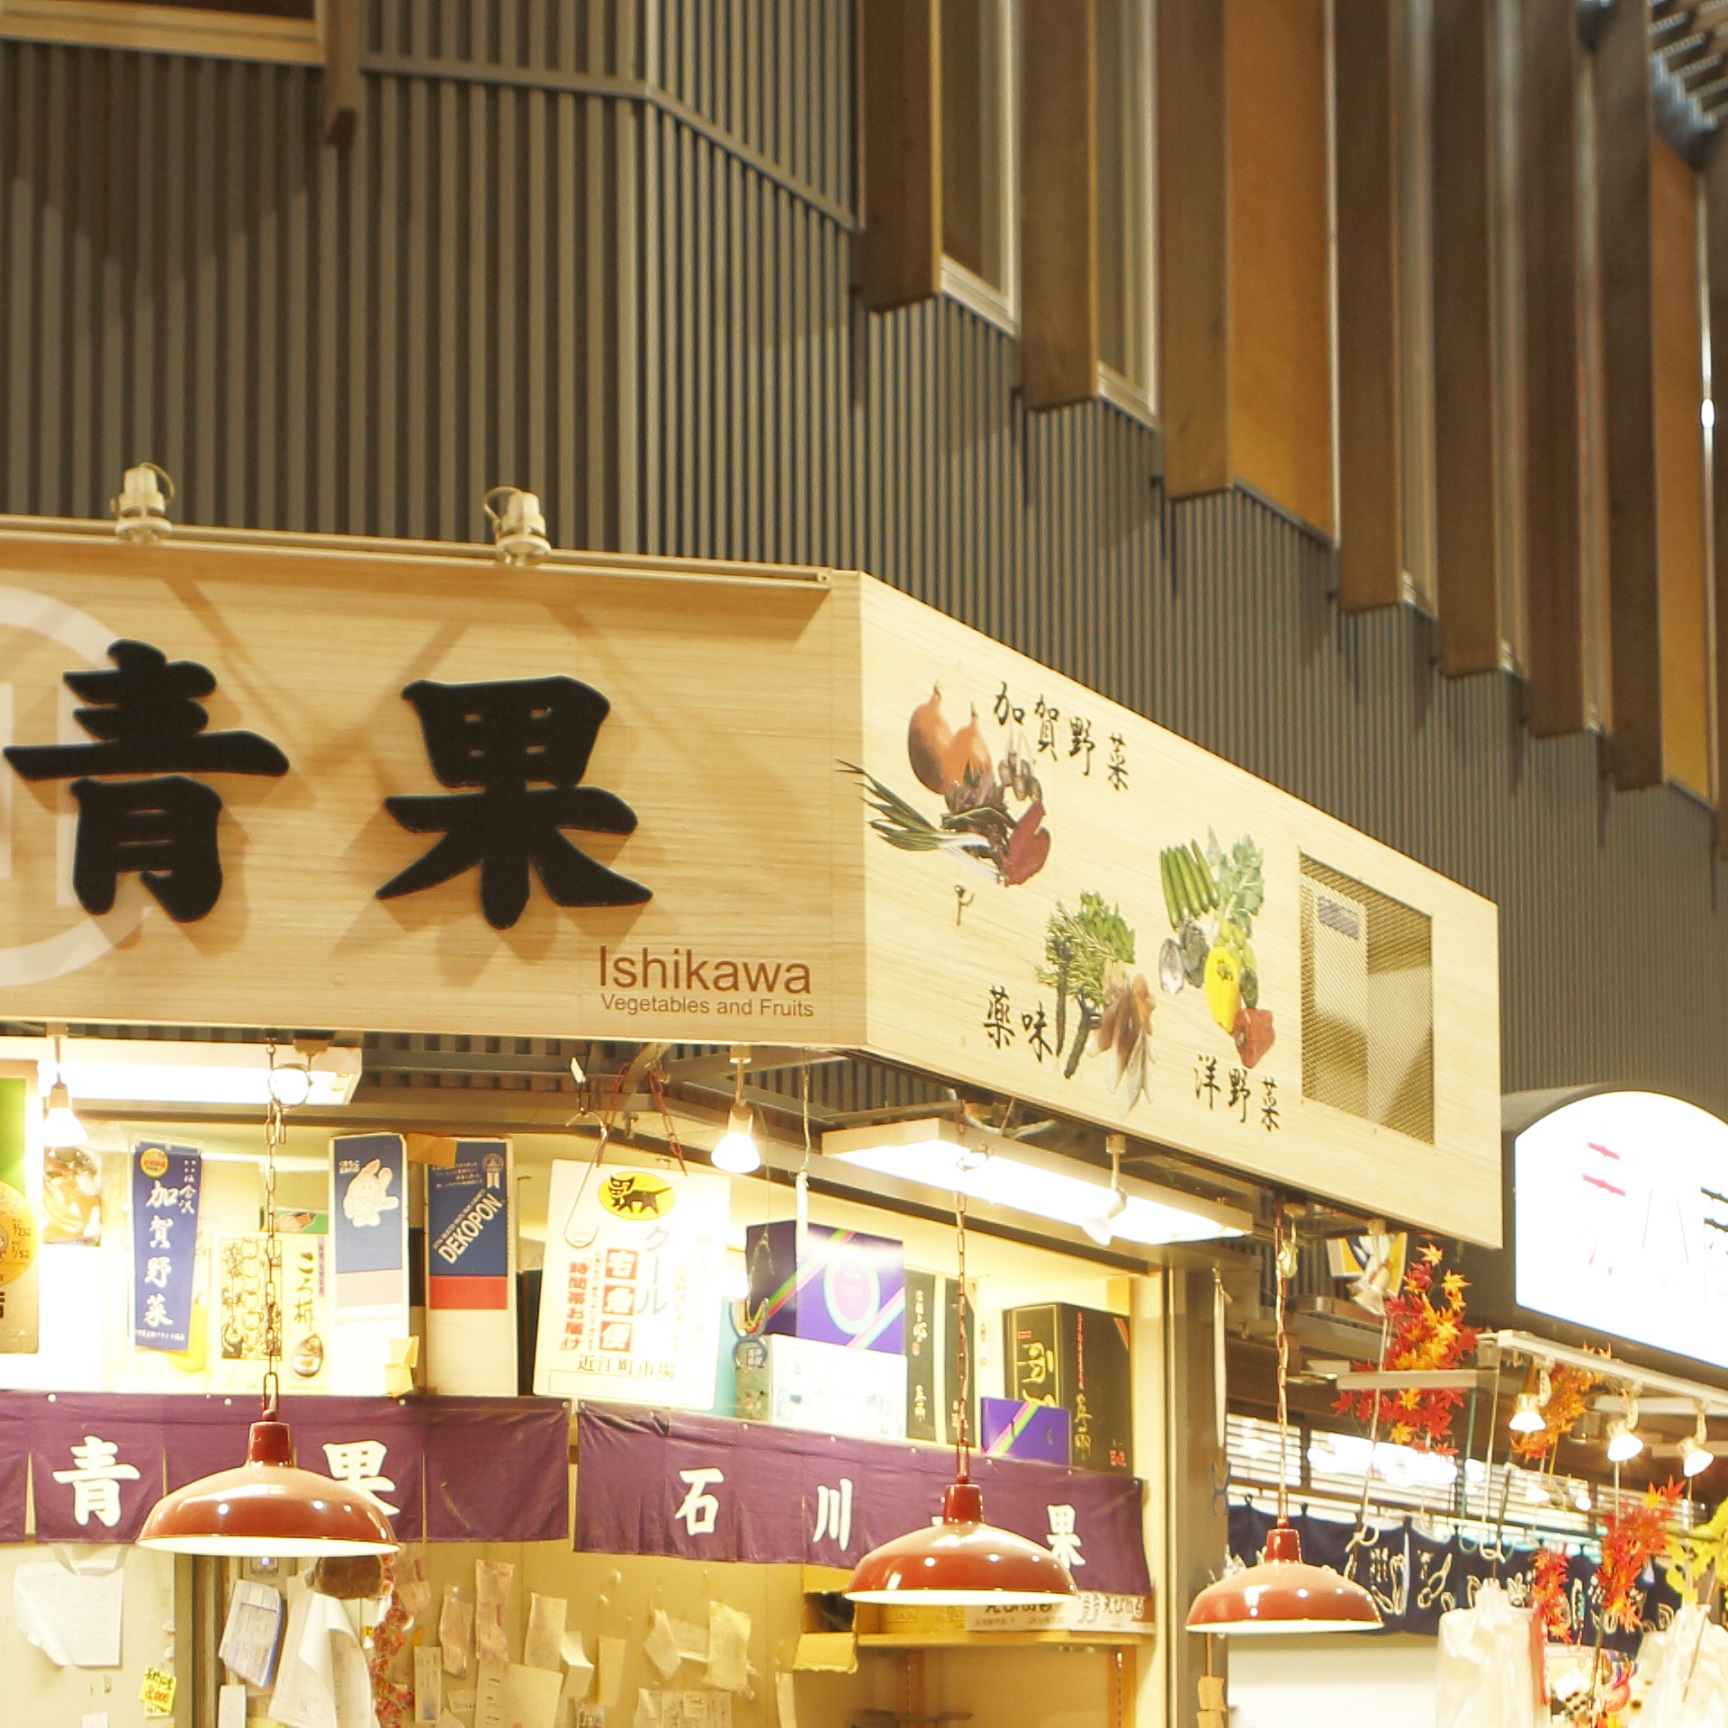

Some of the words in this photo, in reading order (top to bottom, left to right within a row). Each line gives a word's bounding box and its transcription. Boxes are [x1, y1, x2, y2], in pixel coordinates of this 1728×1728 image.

[993, 681, 1129, 791] 加賀野菜
[600, 945, 811, 994] Ishikawa
[601, 993, 710, 1015] Vegetables
[717, 999, 753, 1016] and
[760, 998, 814, 1017] Fruits
[983, 985, 1053, 1063] 薬味
[1194, 1055, 1280, 1132] 洋野菜
[144, 1180, 179, 1328] 加賀野菜
[438, 1193, 503, 1264] DEKOPON
[577, 1355, 675, 1378] 近江町市場
